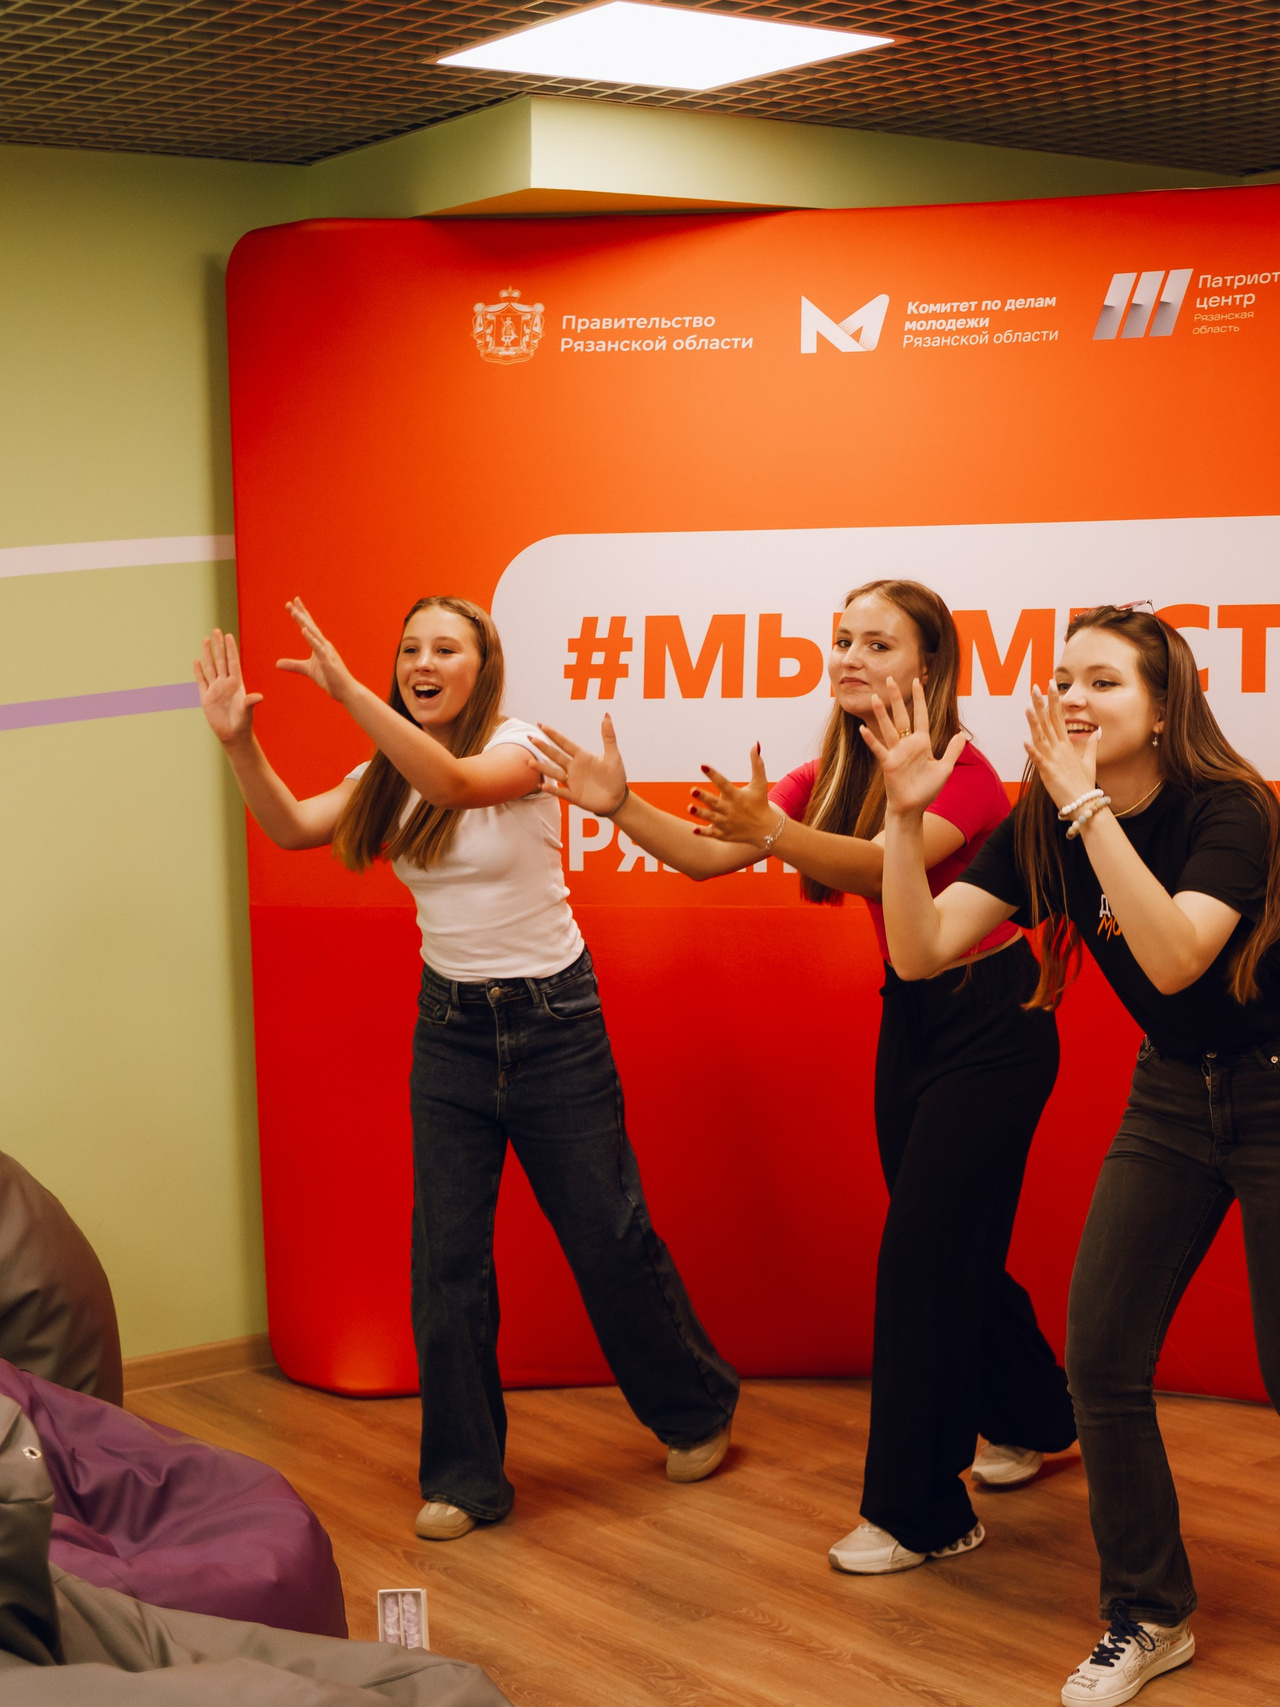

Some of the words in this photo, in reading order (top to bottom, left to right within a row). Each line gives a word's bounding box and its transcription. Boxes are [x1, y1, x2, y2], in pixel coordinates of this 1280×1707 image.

[906, 301, 978, 316] Комитет
[981, 298, 1002, 312] по
[1004, 296, 1057, 312] делам
[1195, 292, 1256, 310] центр
[561, 313, 716, 333] Правительство
[904, 316, 990, 332] молодежи
[1194, 311, 1254, 323] Рязанская
[902, 331, 989, 348] Рязанской
[992, 329, 1059, 344] области
[1192, 324, 1240, 335] область
[560, 336, 667, 353] Рязанской
[672, 335, 754, 351] области
